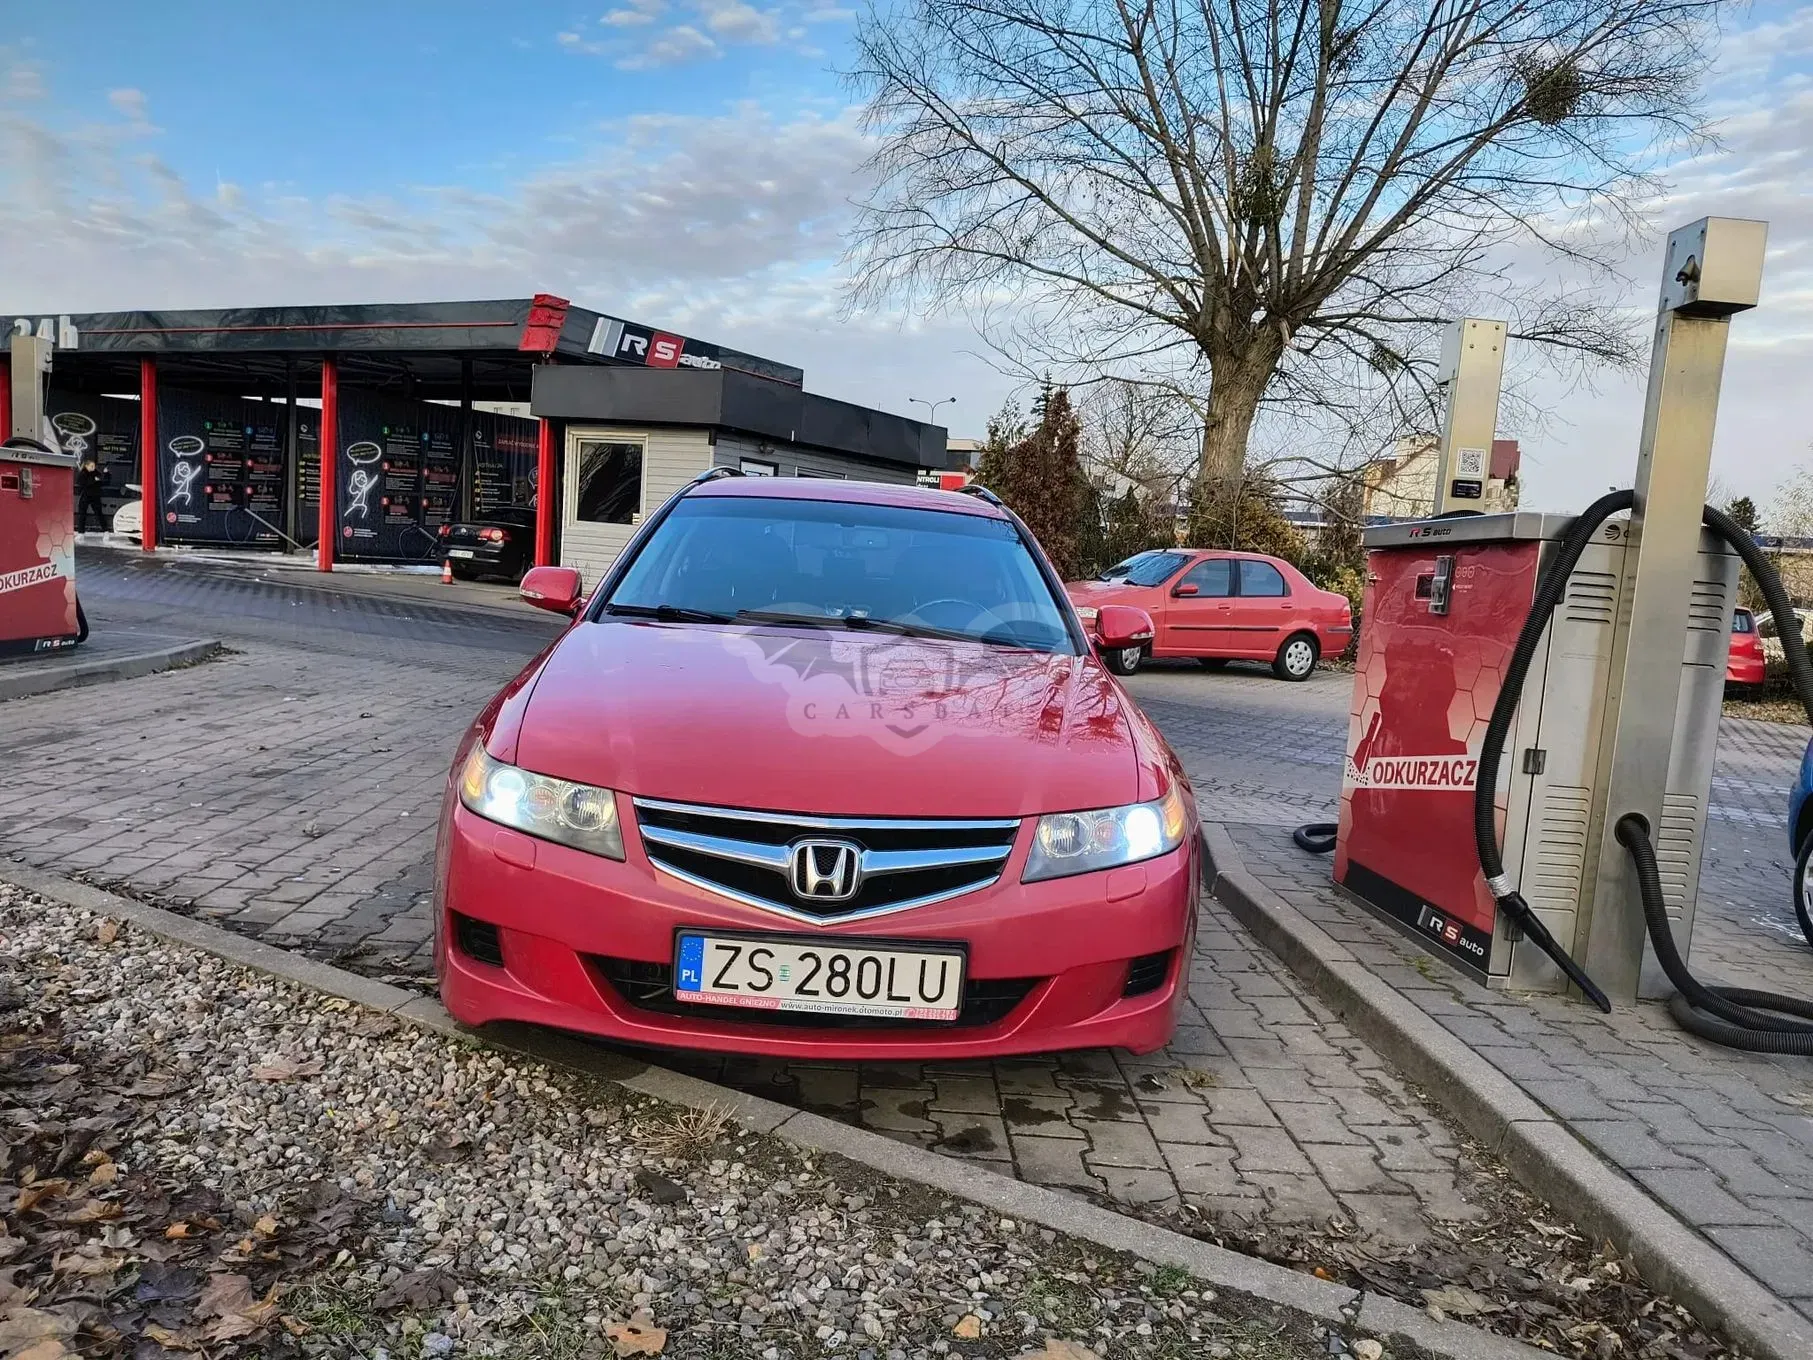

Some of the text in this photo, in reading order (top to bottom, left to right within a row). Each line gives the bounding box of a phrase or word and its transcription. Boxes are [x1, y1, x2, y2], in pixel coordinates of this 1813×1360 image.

[14, 315, 78, 349] 24h
[679, 353, 722, 369] auto
[1433, 528, 1452, 536] auto
[1373, 760, 1477, 786] ODKURZACZ
[1459, 937, 1484, 956] auto
[681, 968, 698, 982] PL
[712, 944, 947, 1003] ZS 280LU
[680, 992, 776, 1008] AUTO-HANDEL GNIEZNO
[780, 1001, 903, 1017] www.auto-mironek.otomoto.pl
